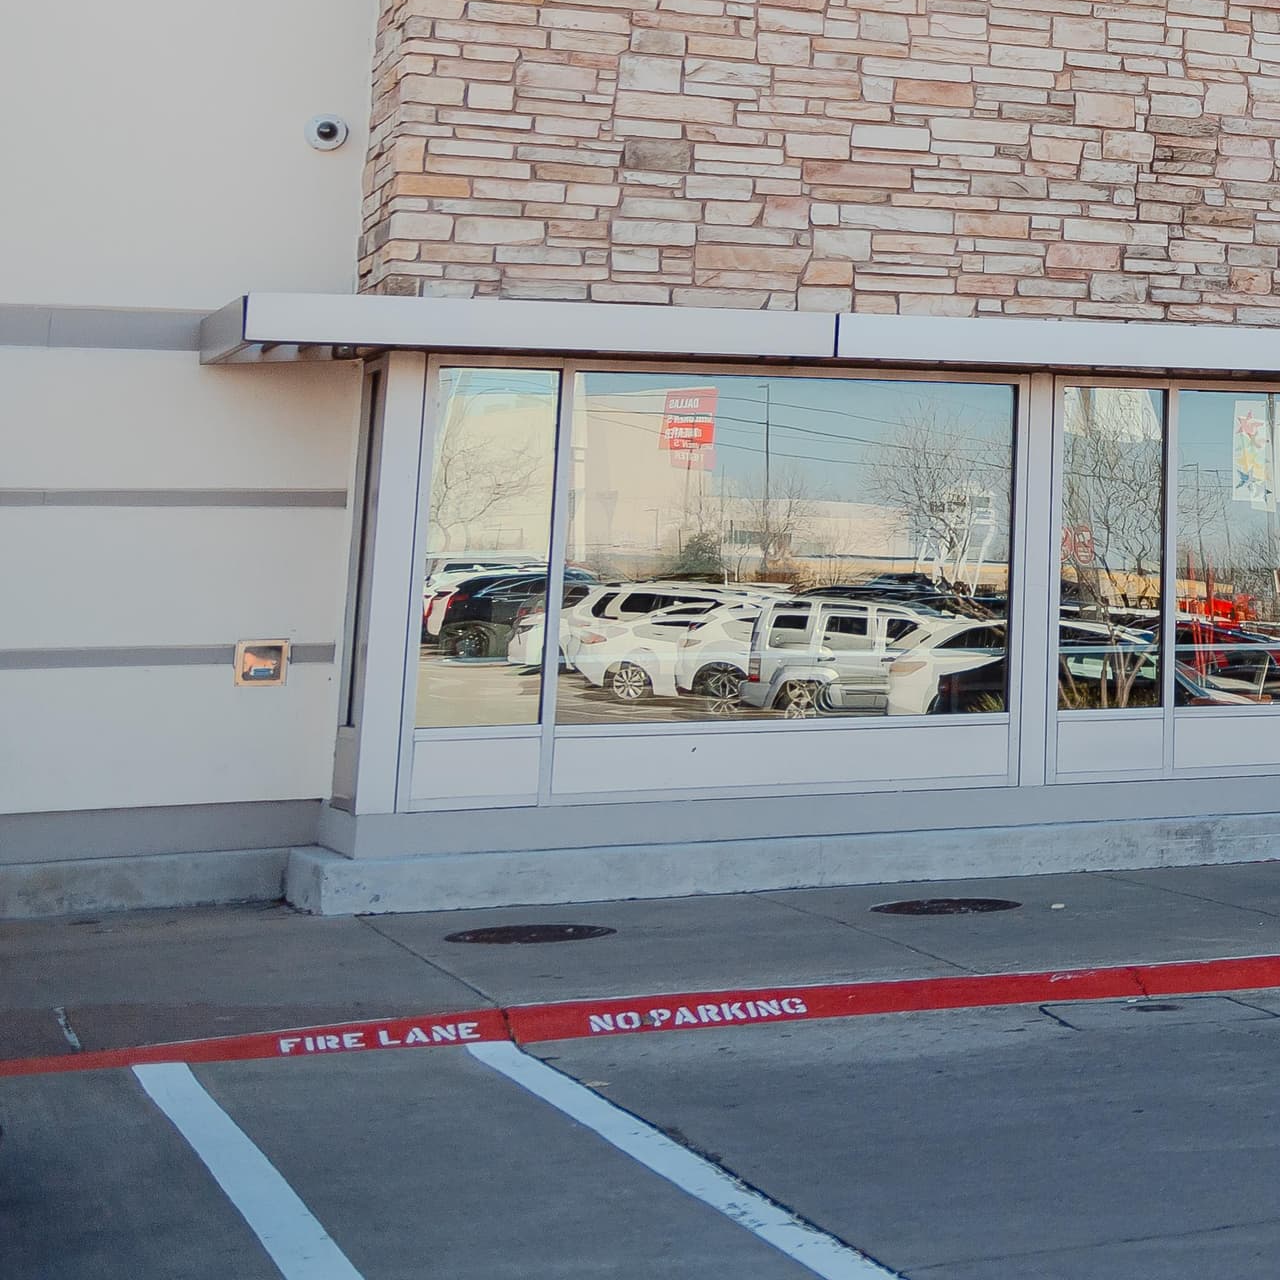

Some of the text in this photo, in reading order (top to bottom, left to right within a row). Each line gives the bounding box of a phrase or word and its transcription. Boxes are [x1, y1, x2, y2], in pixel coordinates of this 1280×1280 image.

[589, 997, 807, 1032] NO PARKING
[280, 1022, 481, 1053] FIRE LANE
